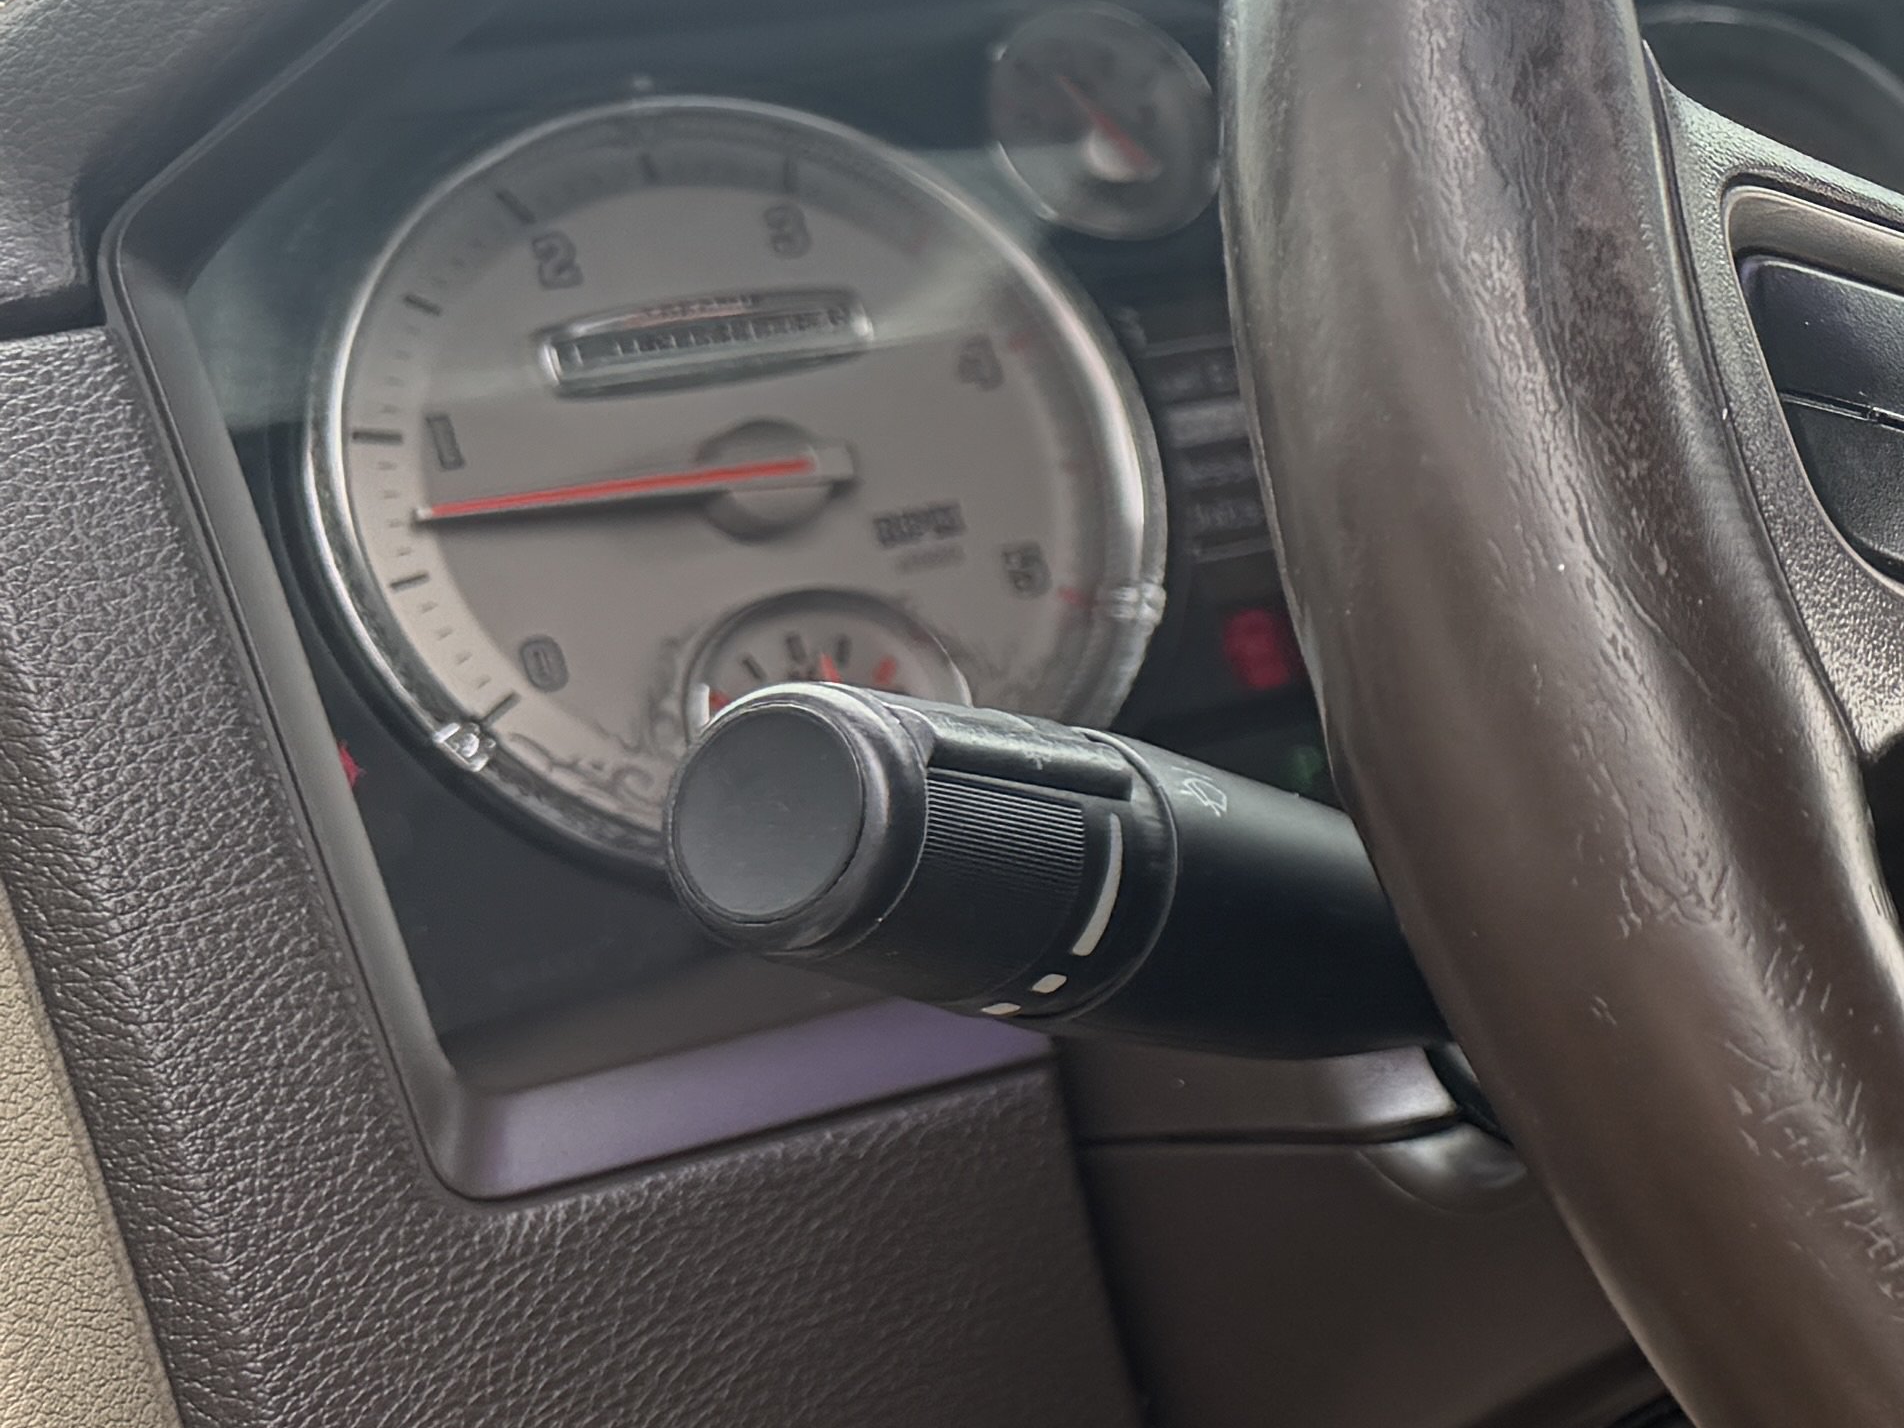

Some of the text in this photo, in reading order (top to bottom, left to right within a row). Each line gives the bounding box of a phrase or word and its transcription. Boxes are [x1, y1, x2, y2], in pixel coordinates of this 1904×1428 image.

[531, 229, 584, 291] 2
[1001, 540, 1053, 600] 5
[517, 633, 570, 693] 0
